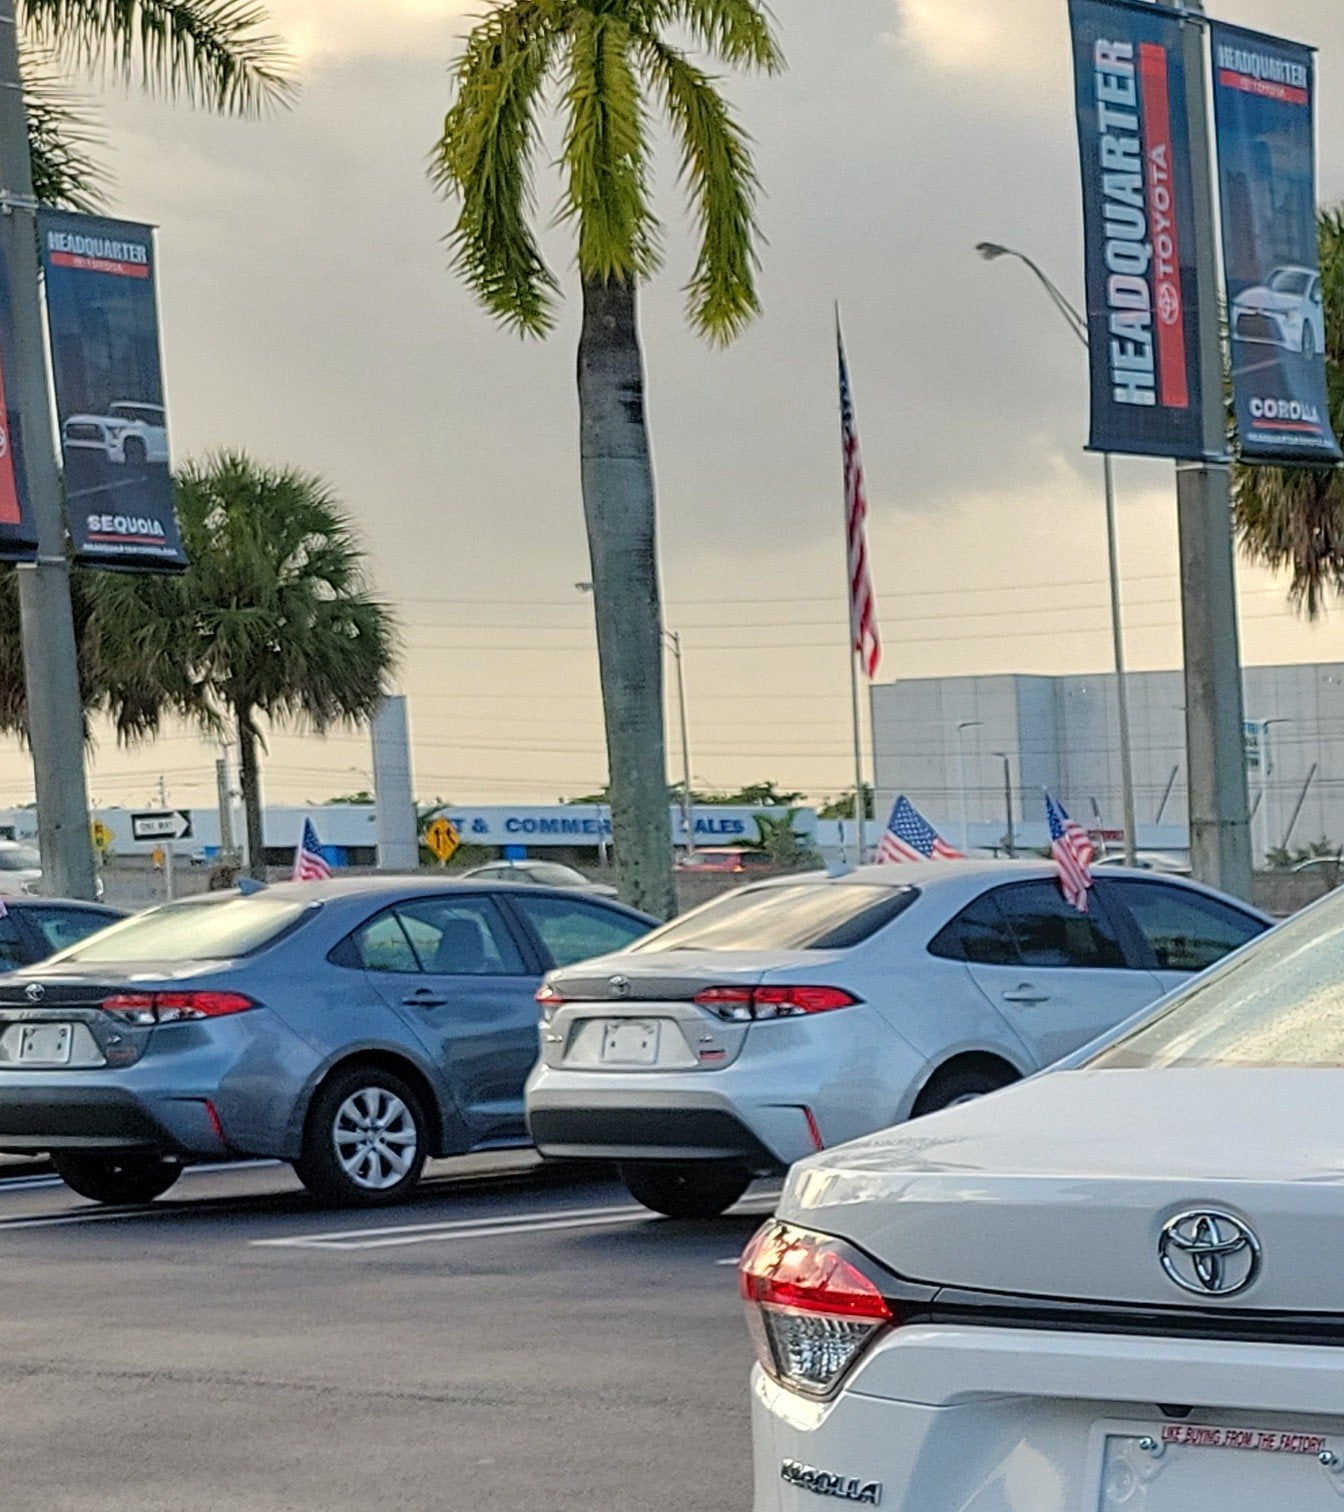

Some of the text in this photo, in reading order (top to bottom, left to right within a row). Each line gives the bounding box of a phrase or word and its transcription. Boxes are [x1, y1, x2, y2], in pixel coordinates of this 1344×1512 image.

[1217, 45, 1307, 88] HEADQUARTER
[1094, 38, 1156, 406] HEADQUARTER
[1151, 142, 1174, 277] TOYOTA
[47, 231, 148, 264] HEADQUARTER
[87, 514, 165, 537] SEQUOIA
[472, 817, 489, 833] &
[1161, 1425, 1183, 1442] LIKE
[1185, 1427, 1221, 1445] BUYING
[1224, 1429, 1254, 1448] FROM
[1257, 1432, 1277, 1450] THE
